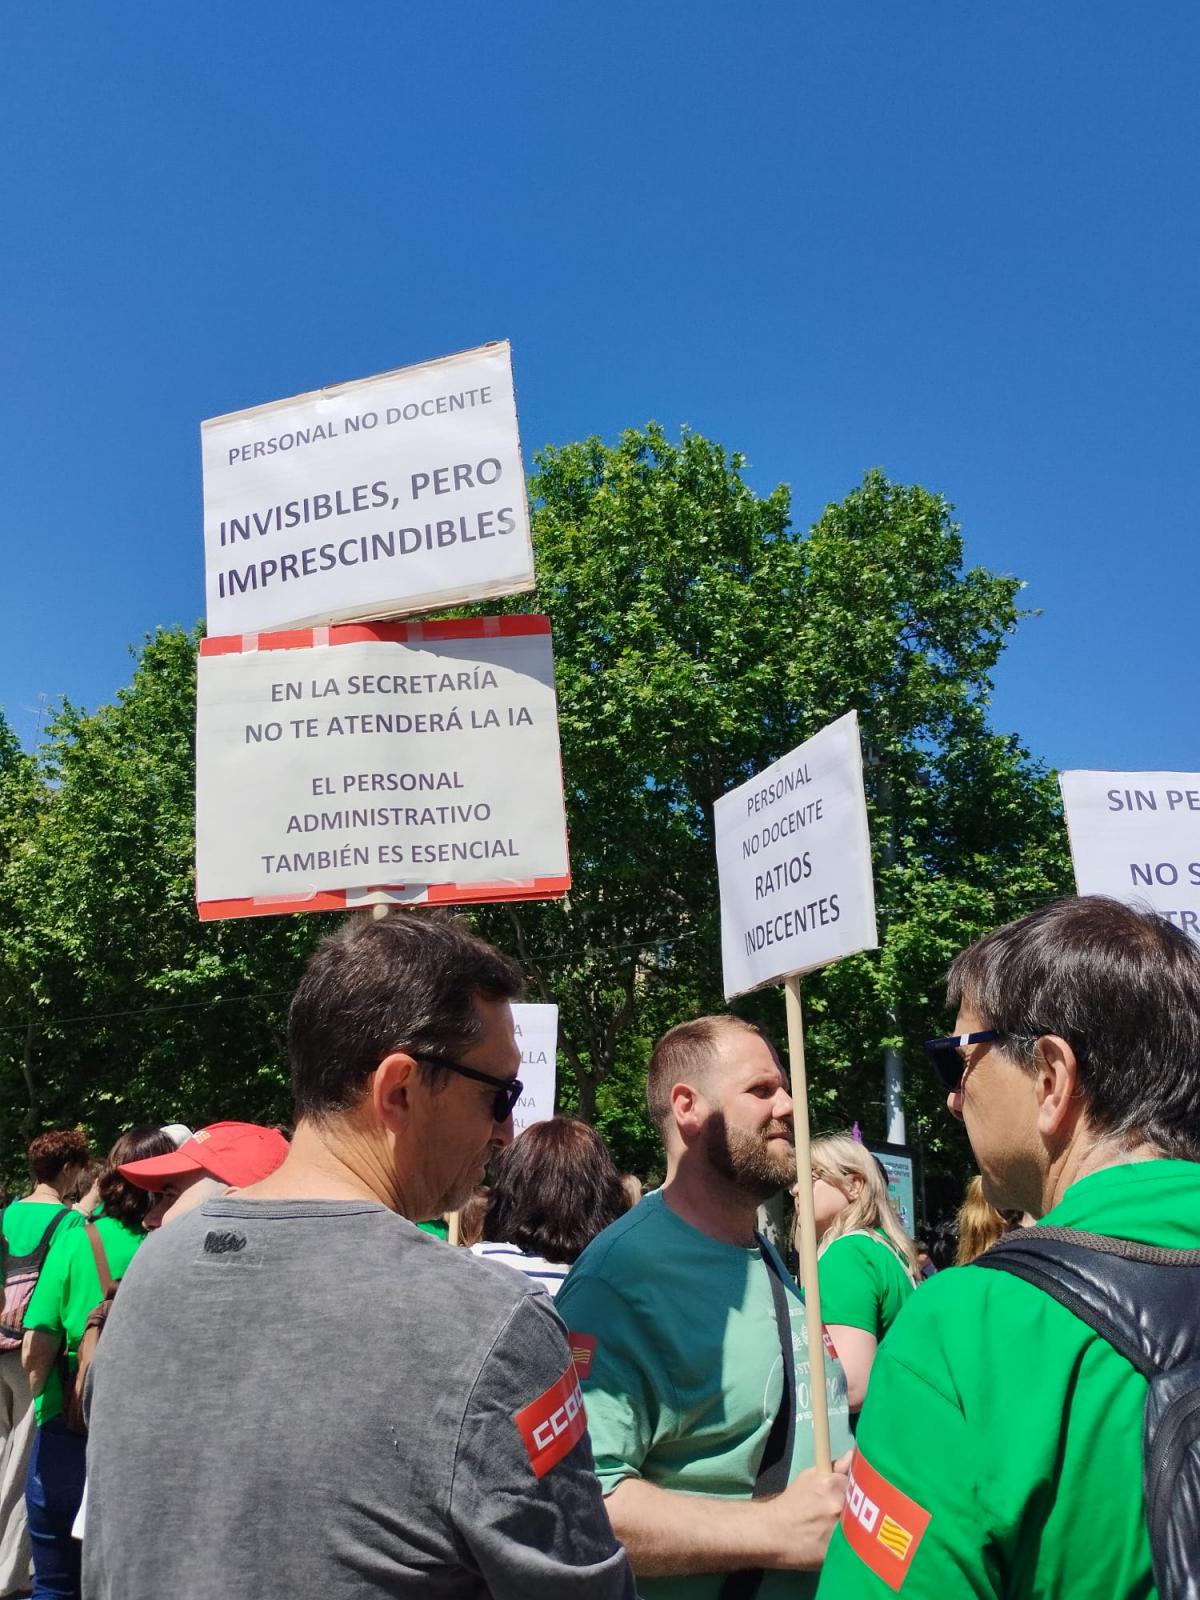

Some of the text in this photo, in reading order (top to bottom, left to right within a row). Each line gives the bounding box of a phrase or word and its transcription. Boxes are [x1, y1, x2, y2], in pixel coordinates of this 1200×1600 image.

[228, 385, 493, 466] PERSONAL NO DOCENTE
[219, 457, 502, 548] INVISIBLES, PERO
[218, 507, 516, 599] IMPRESCINDIBLES
[271, 666, 499, 703] EN LA SECRETARÍA
[245, 705, 534, 744] NO TE ATENDERÁ LA IA
[312, 771, 464, 797] EL PERSONAL
[747, 763, 812, 816] PERSONAL
[1107, 789, 1158, 812] SIN
[286, 802, 491, 835] ADMINISTRATIVO
[742, 798, 824, 861] NO DOCENTE
[261, 838, 520, 874] TAMBIÉN ES ESENCIAL
[755, 851, 813, 901] RATIOS
[1129, 862, 1179, 887] NO
[744, 893, 841, 957] INDECENTES
